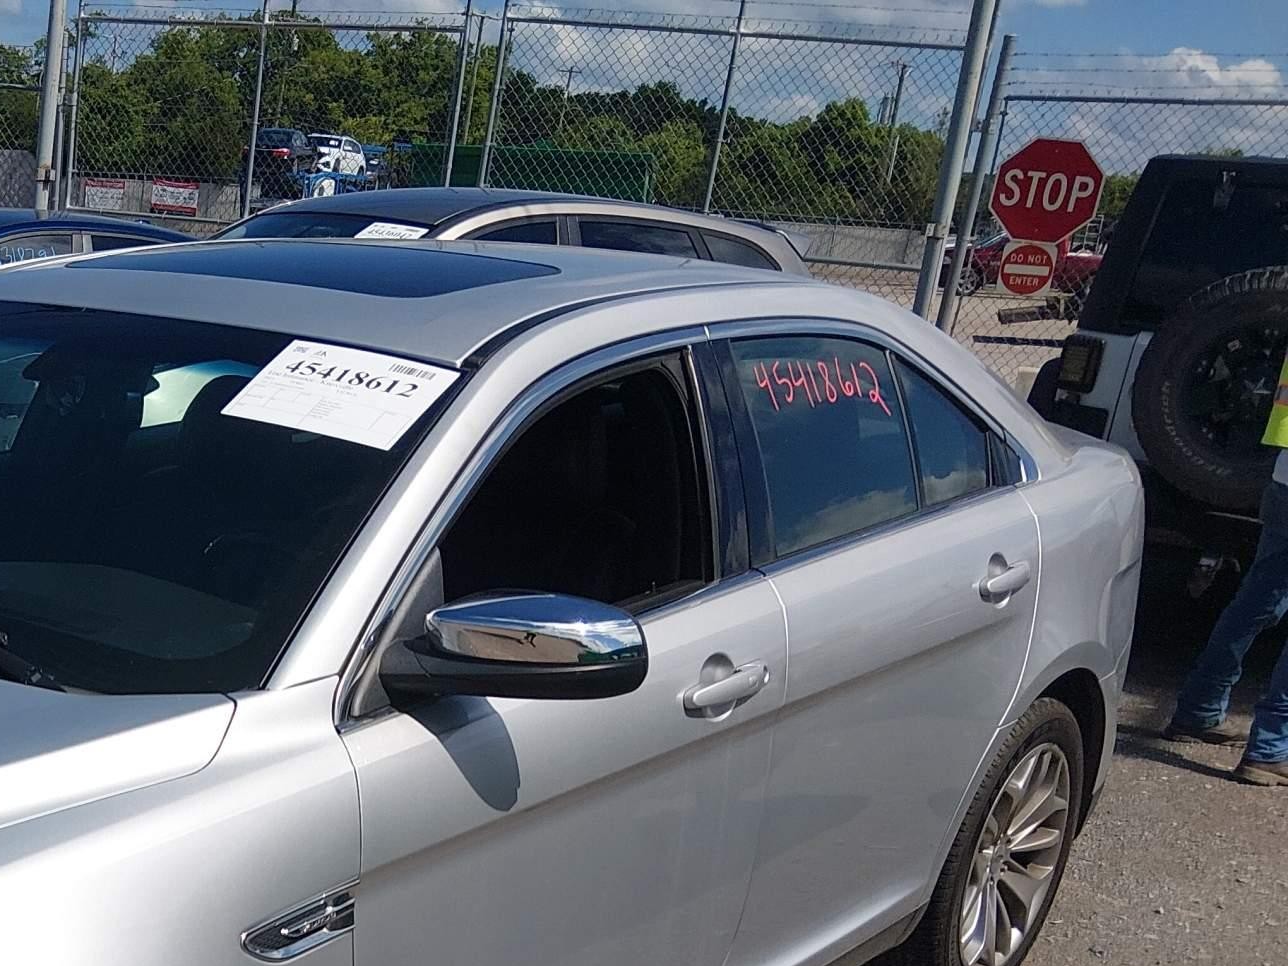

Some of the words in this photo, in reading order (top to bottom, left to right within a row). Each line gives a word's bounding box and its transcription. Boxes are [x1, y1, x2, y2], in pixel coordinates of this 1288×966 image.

[999, 168, 1095, 213] STOP
[1010, 253, 1024, 264] DO
[1027, 254, 1048, 265] NOT
[1009, 275, 1039, 287] ENTER
[285, 359, 419, 398] 45418612
[753, 356, 892, 417] 45418612
